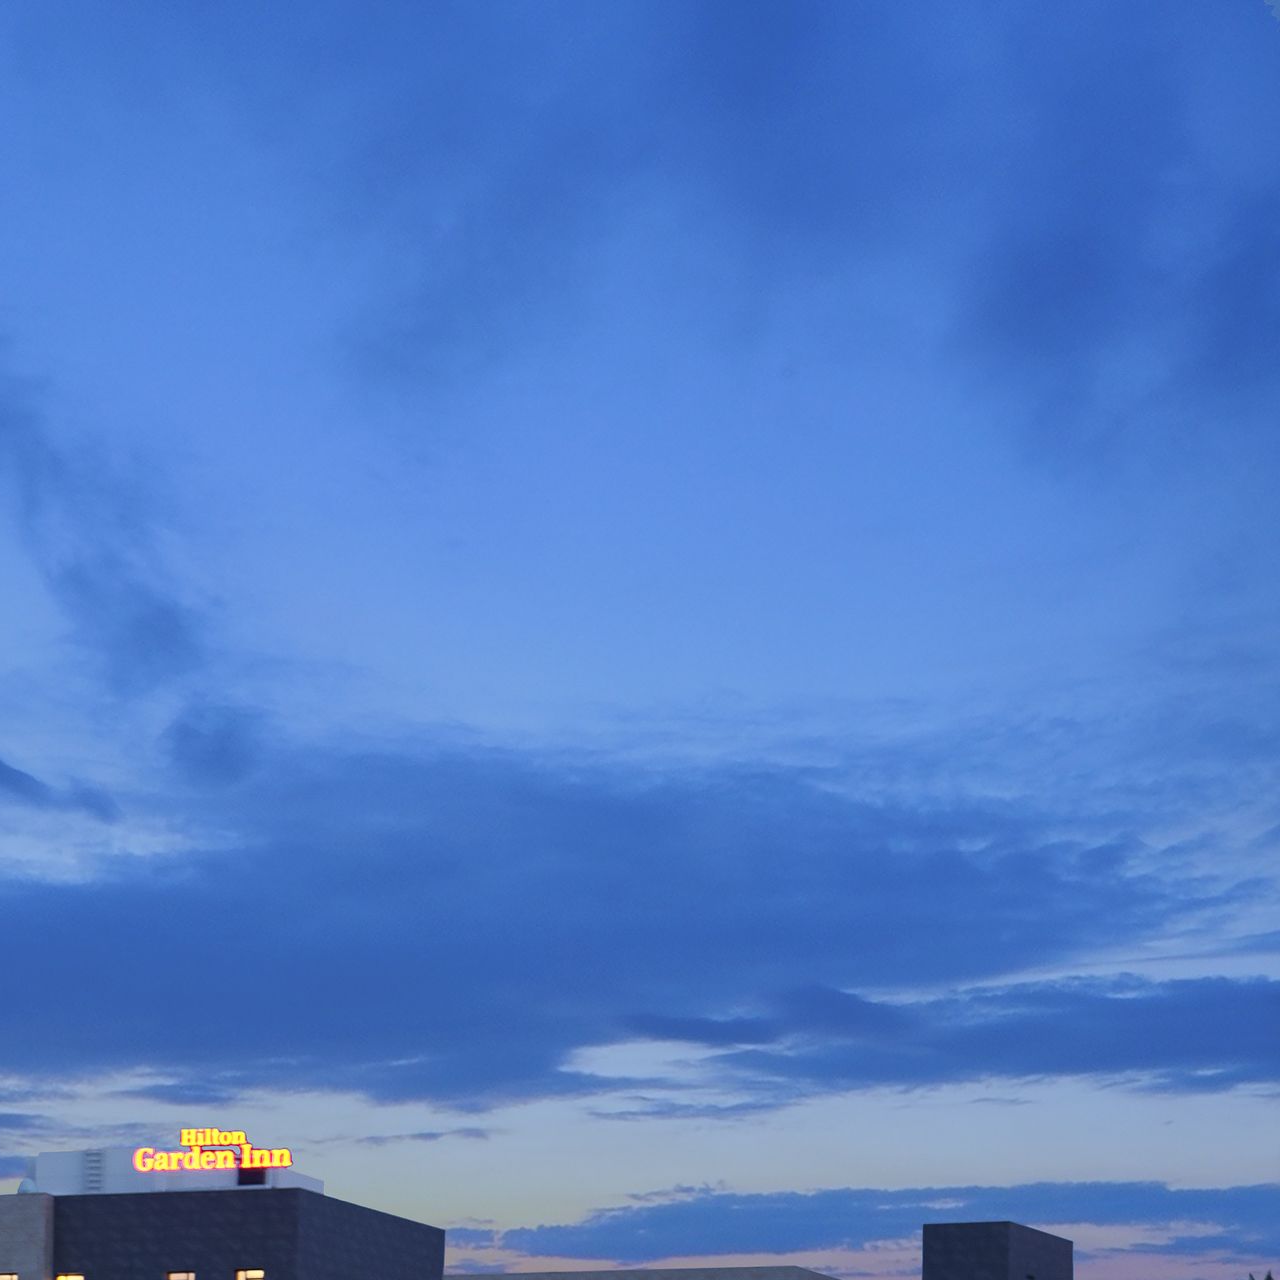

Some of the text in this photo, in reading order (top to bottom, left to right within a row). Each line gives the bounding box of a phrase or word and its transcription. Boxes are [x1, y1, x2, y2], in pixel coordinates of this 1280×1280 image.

[180, 1128, 247, 1146] Hilton
[133, 1143, 293, 1172] Garden Inn
